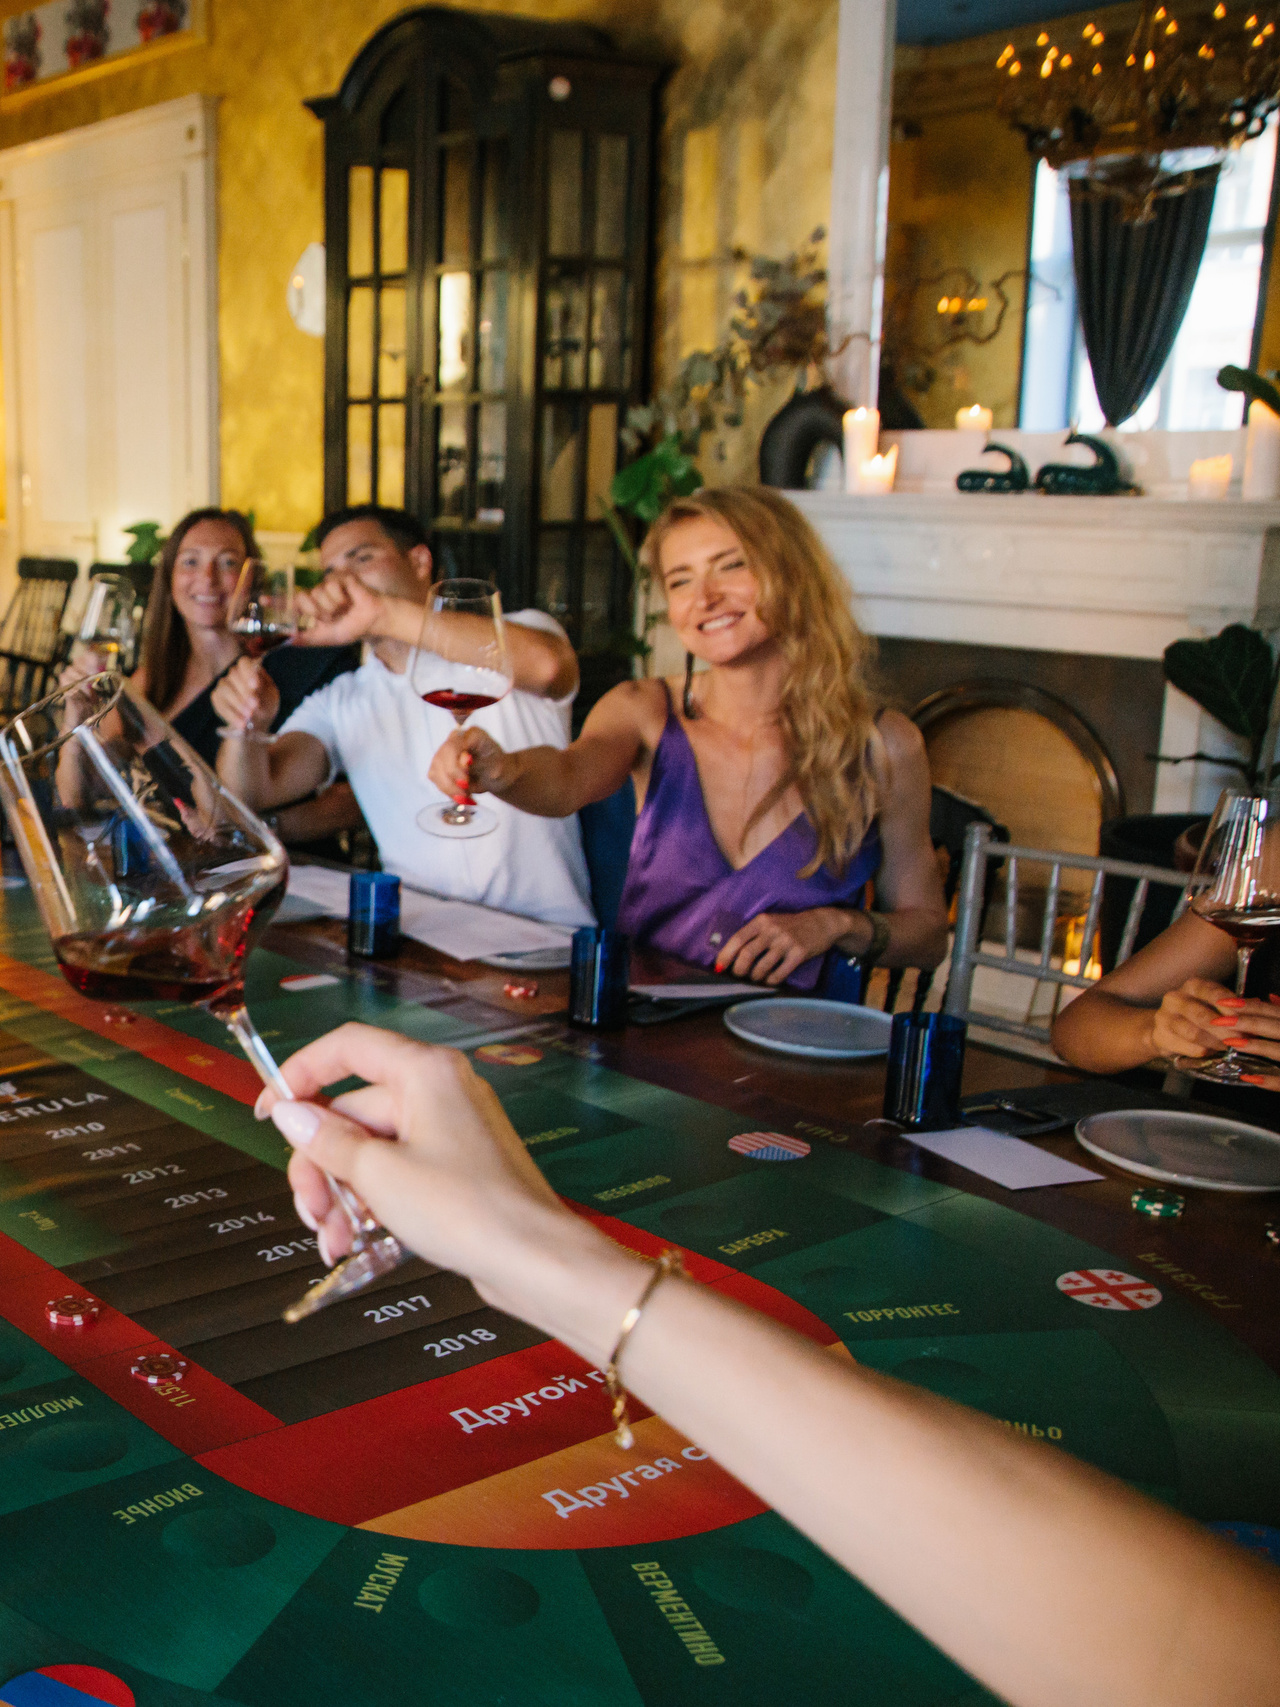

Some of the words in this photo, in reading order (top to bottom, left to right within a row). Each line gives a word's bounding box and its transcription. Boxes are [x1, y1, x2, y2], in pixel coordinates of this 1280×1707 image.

[45, 1121, 106, 1140] 2010
[82, 1143, 142, 1161] 2011
[122, 1164, 186, 1185] 2012
[164, 1188, 228, 1209] 2013
[209, 1211, 275, 1234] 2014
[257, 1237, 319, 1262] 2015
[363, 1294, 432, 1324] 2017
[843, 1303, 961, 1324] ТОРРОНТЕС
[423, 1328, 497, 1358] 2018
[449, 1374, 587, 1435] Другой
[541, 1456, 682, 1519] Другая
[112, 1482, 204, 1526] ВИОНЬЕ
[353, 1552, 409, 1614] МУСКАТ
[631, 1561, 726, 1667] ВЕРМЕНТИНО
